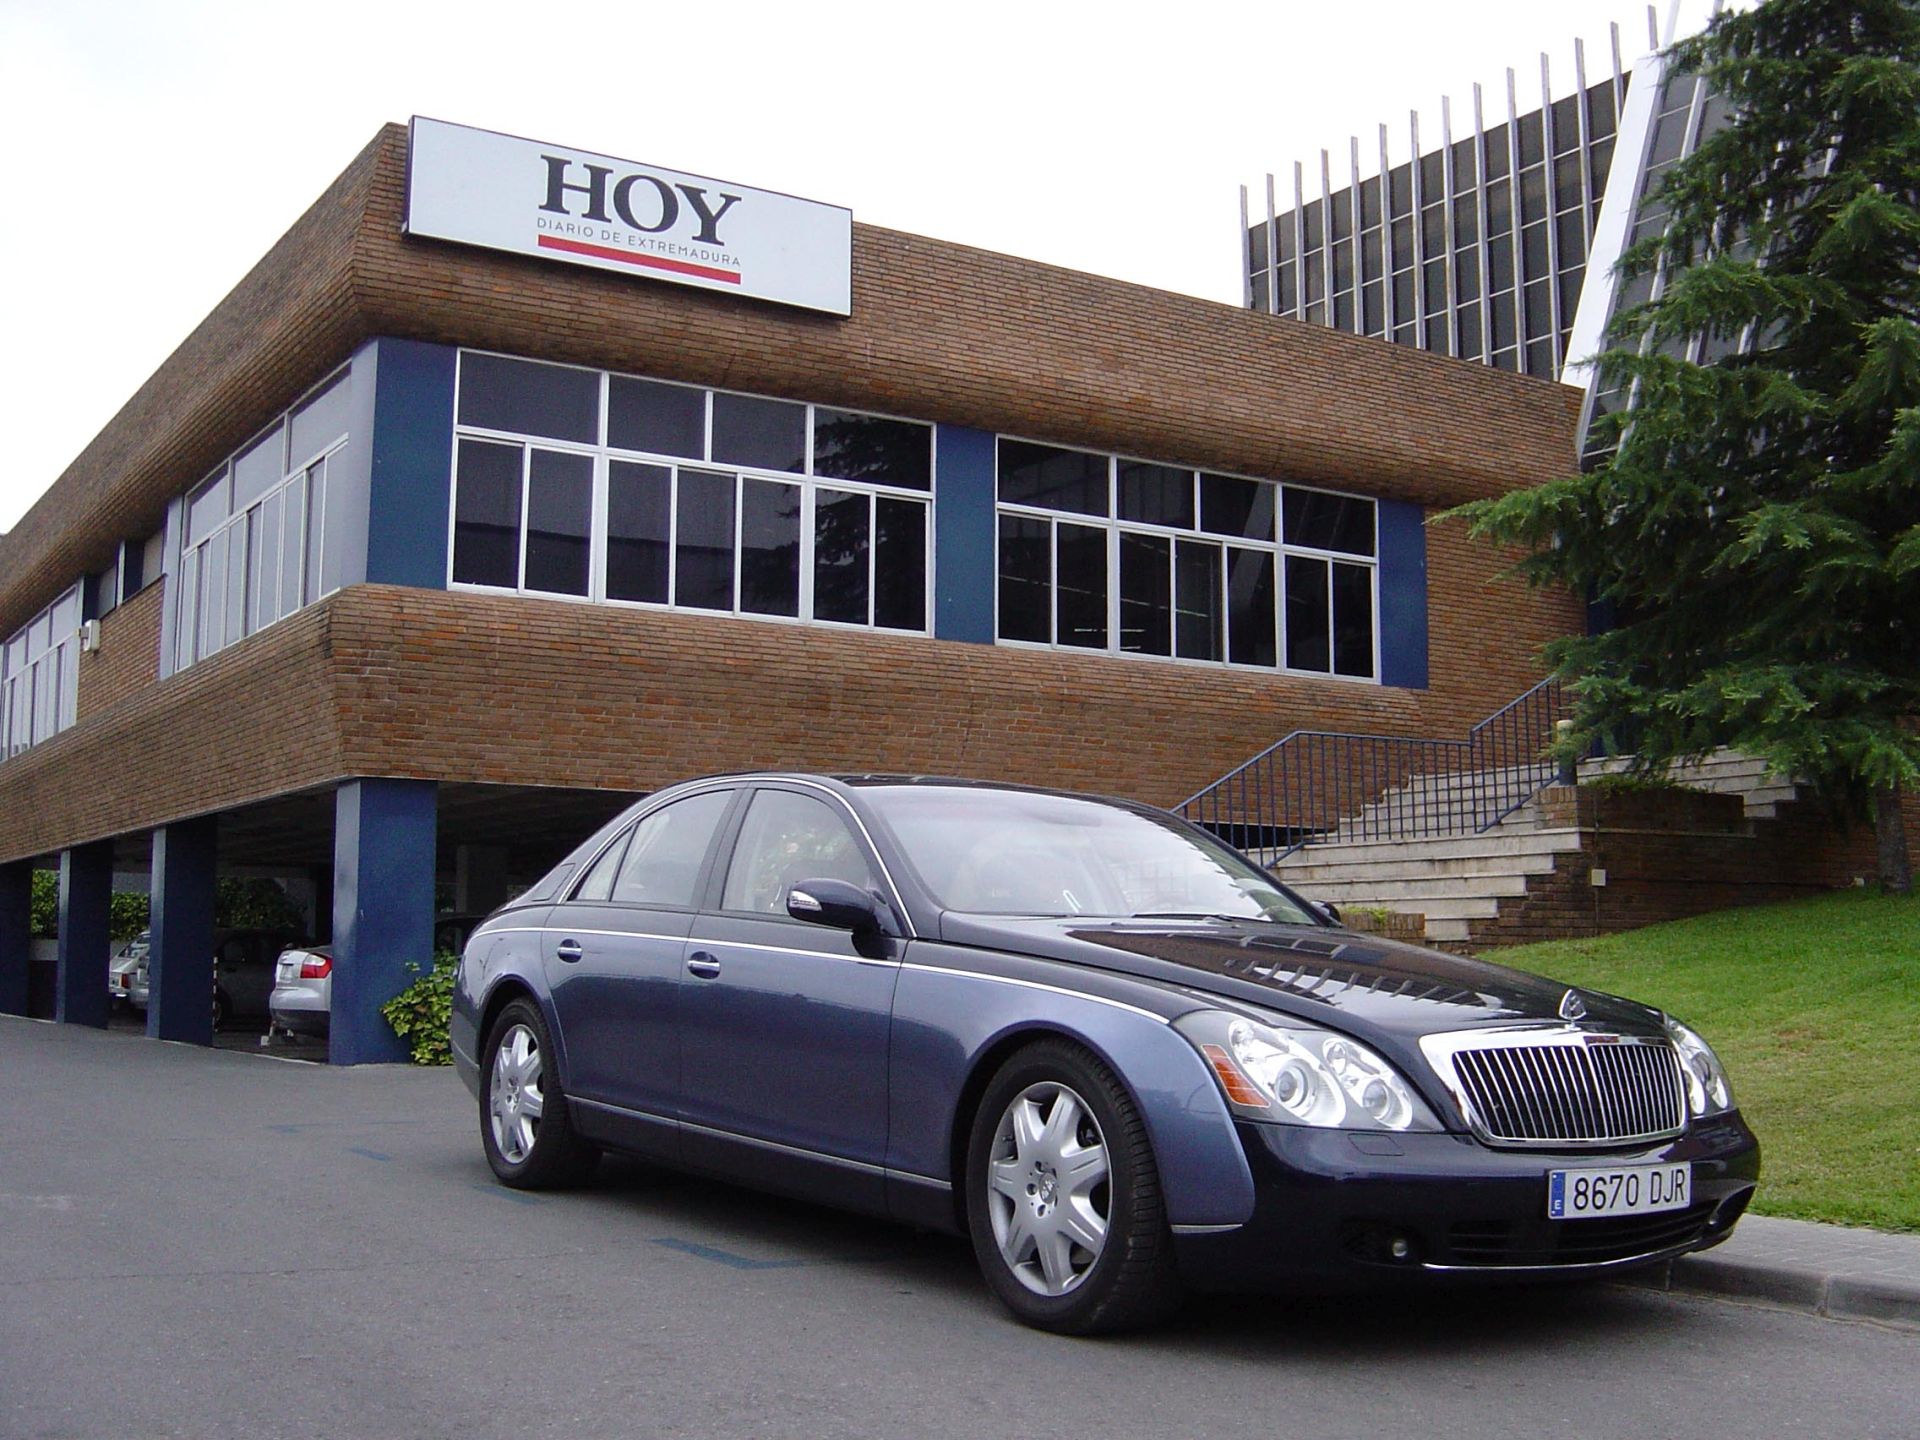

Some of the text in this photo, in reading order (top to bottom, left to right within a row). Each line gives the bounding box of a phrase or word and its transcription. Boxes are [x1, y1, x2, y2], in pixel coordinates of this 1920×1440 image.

[538, 155, 742, 246] HOY
[537, 217, 741, 267] DIARIO DE EXTREMADURA
[1554, 1199, 1562, 1210] E
[1573, 1168, 1686, 1211] 8670 DJR
